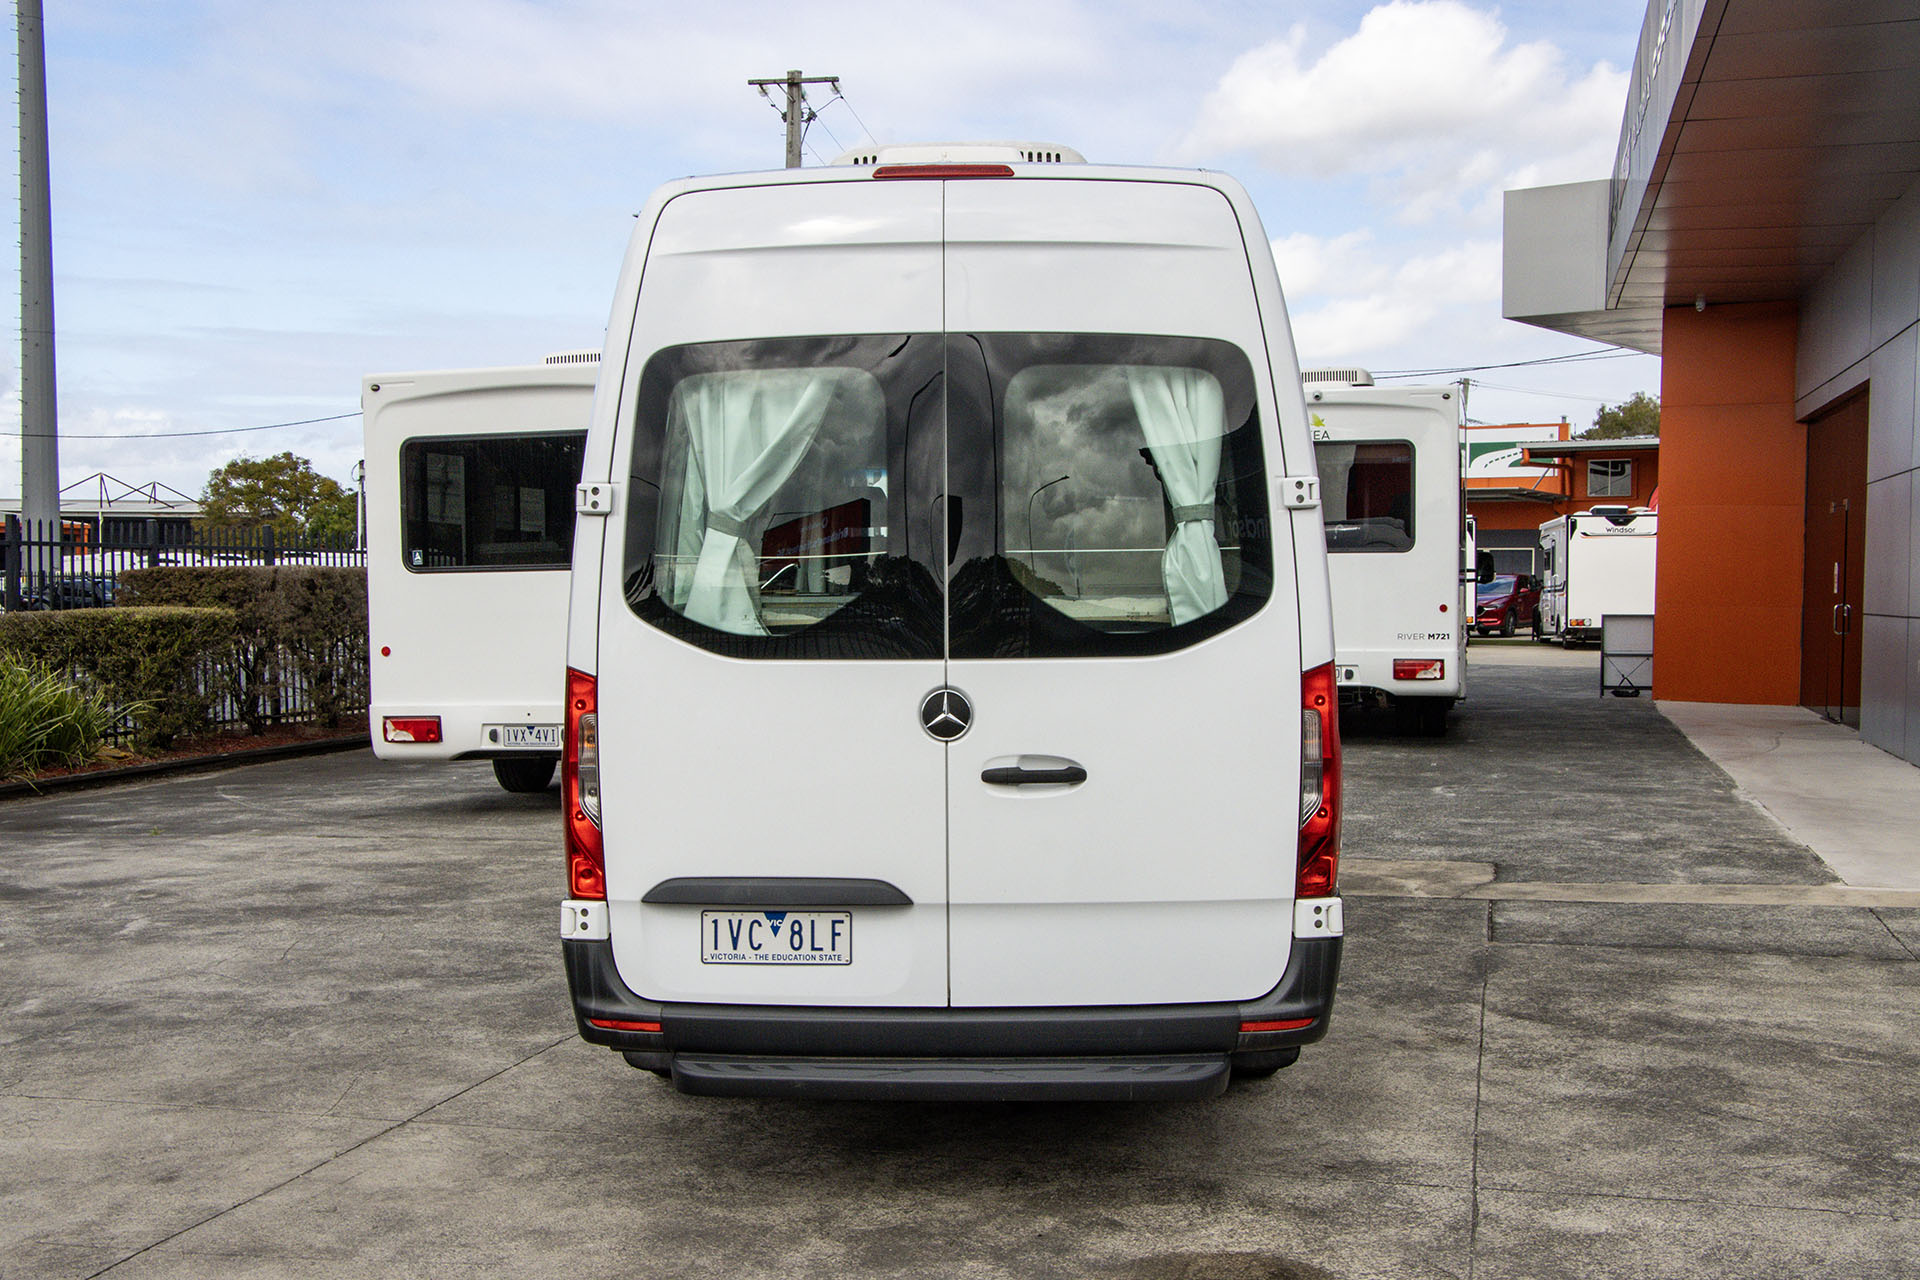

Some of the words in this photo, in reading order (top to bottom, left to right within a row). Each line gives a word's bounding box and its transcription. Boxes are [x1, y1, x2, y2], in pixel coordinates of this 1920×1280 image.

[1310, 430, 1330, 440] EA
[507, 729, 526, 742] 1VX
[535, 729, 555, 742] 4VI
[767, 919, 783, 927] VIC
[711, 919, 763, 951] 1VC
[789, 919, 845, 952] 8LF
[754, 953, 769, 961] THE
[771, 953, 817, 961] EDUCATION
